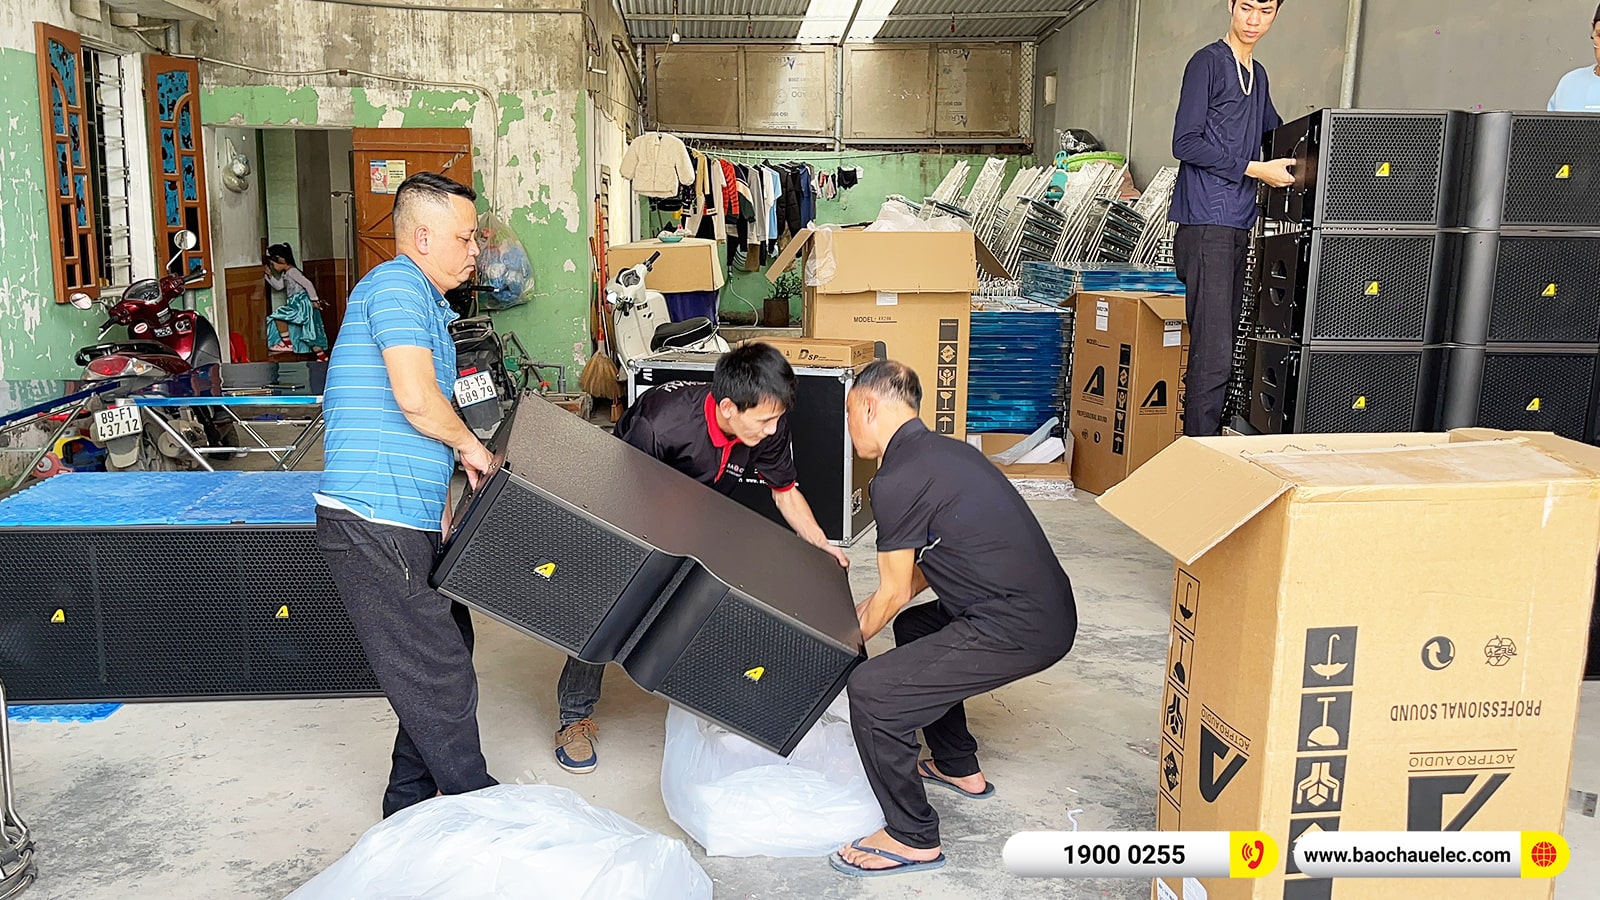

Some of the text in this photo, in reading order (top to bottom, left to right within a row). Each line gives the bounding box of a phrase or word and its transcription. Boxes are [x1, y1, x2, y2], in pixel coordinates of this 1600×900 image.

[457, 374, 487, 392] 29-Y5
[101, 406, 132, 424] 89-F1
[100, 418, 140, 438] 437.12
[1390, 699, 1542, 722] PROFESSIONAL SOUND
[1408, 753, 1516, 768] ACTPRO AUDIO
